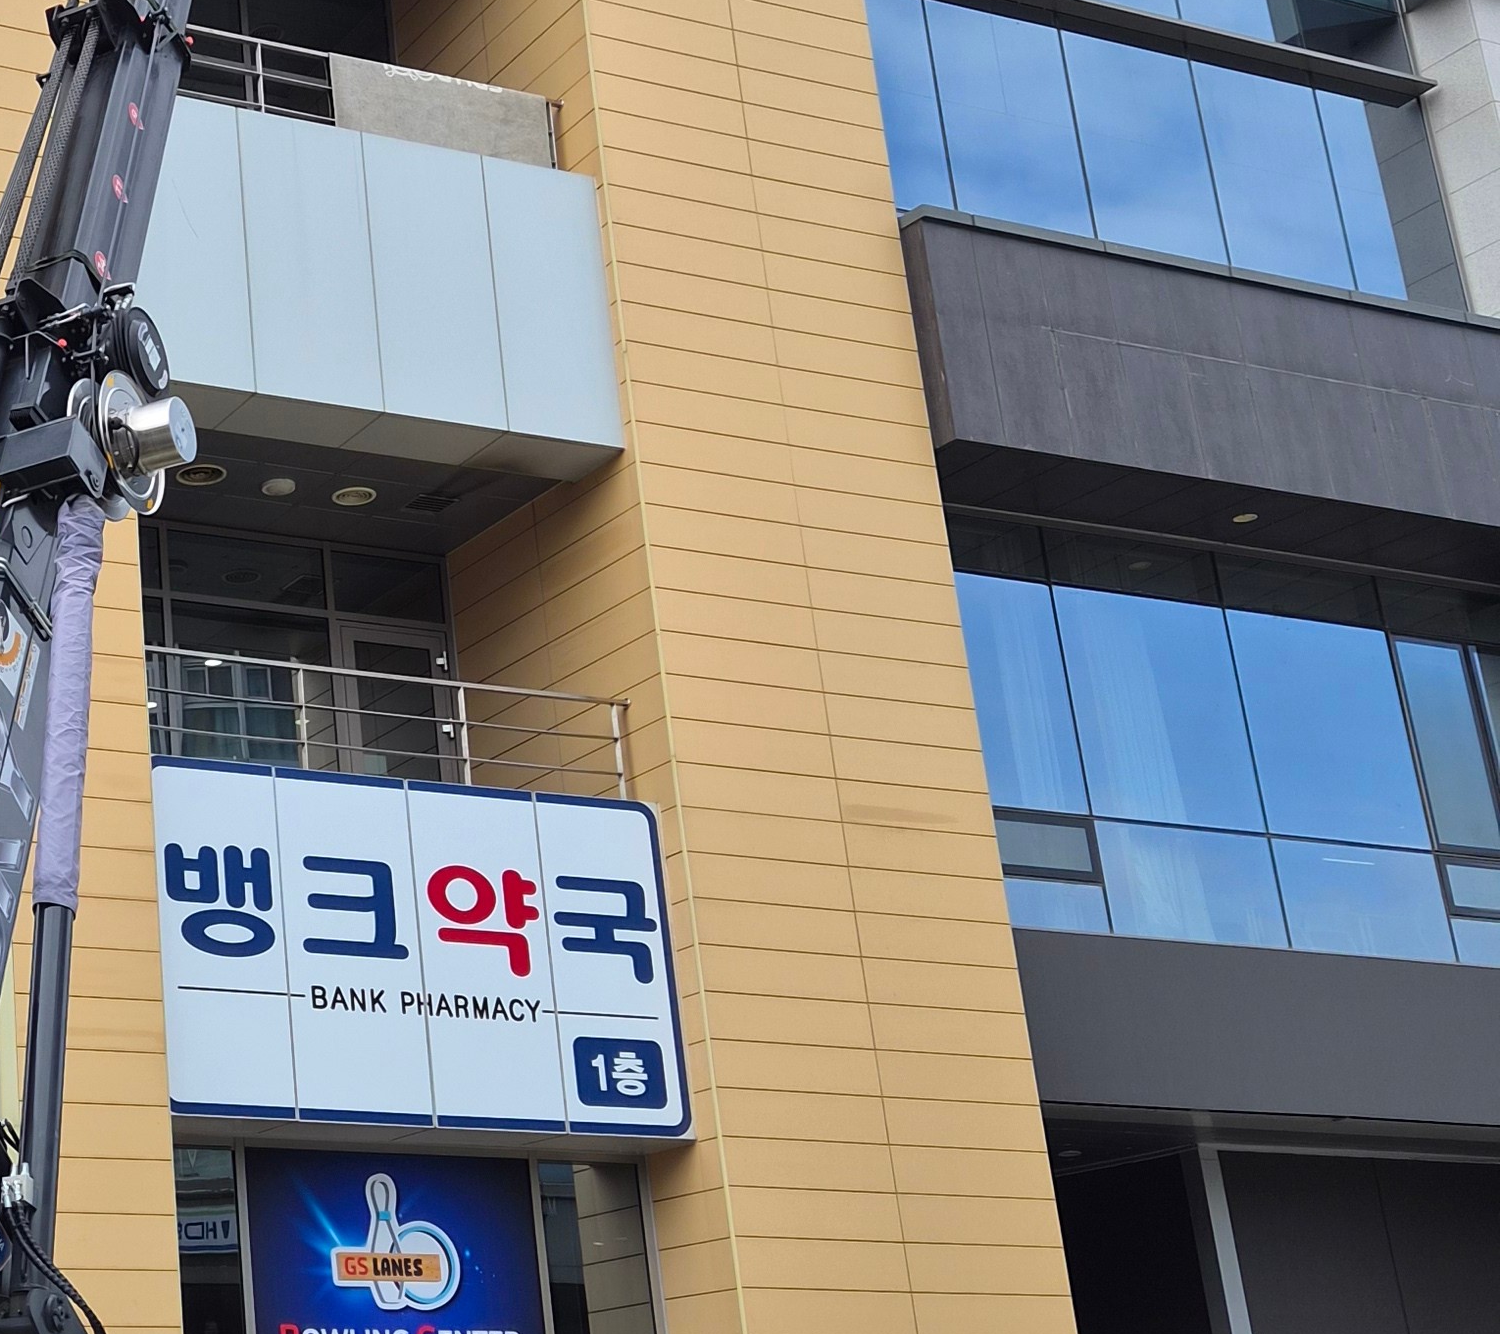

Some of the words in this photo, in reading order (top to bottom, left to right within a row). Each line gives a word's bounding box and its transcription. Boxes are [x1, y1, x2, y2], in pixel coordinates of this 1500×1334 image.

[164, 842, 658, 984] 뱅크약국
[310, 984, 388, 1015] BANK
[399, 991, 541, 1023] PHARMACY
[591, 1051, 649, 1097] 1층
[344, 1256, 369, 1276] GS
[372, 1257, 424, 1277] LANES
